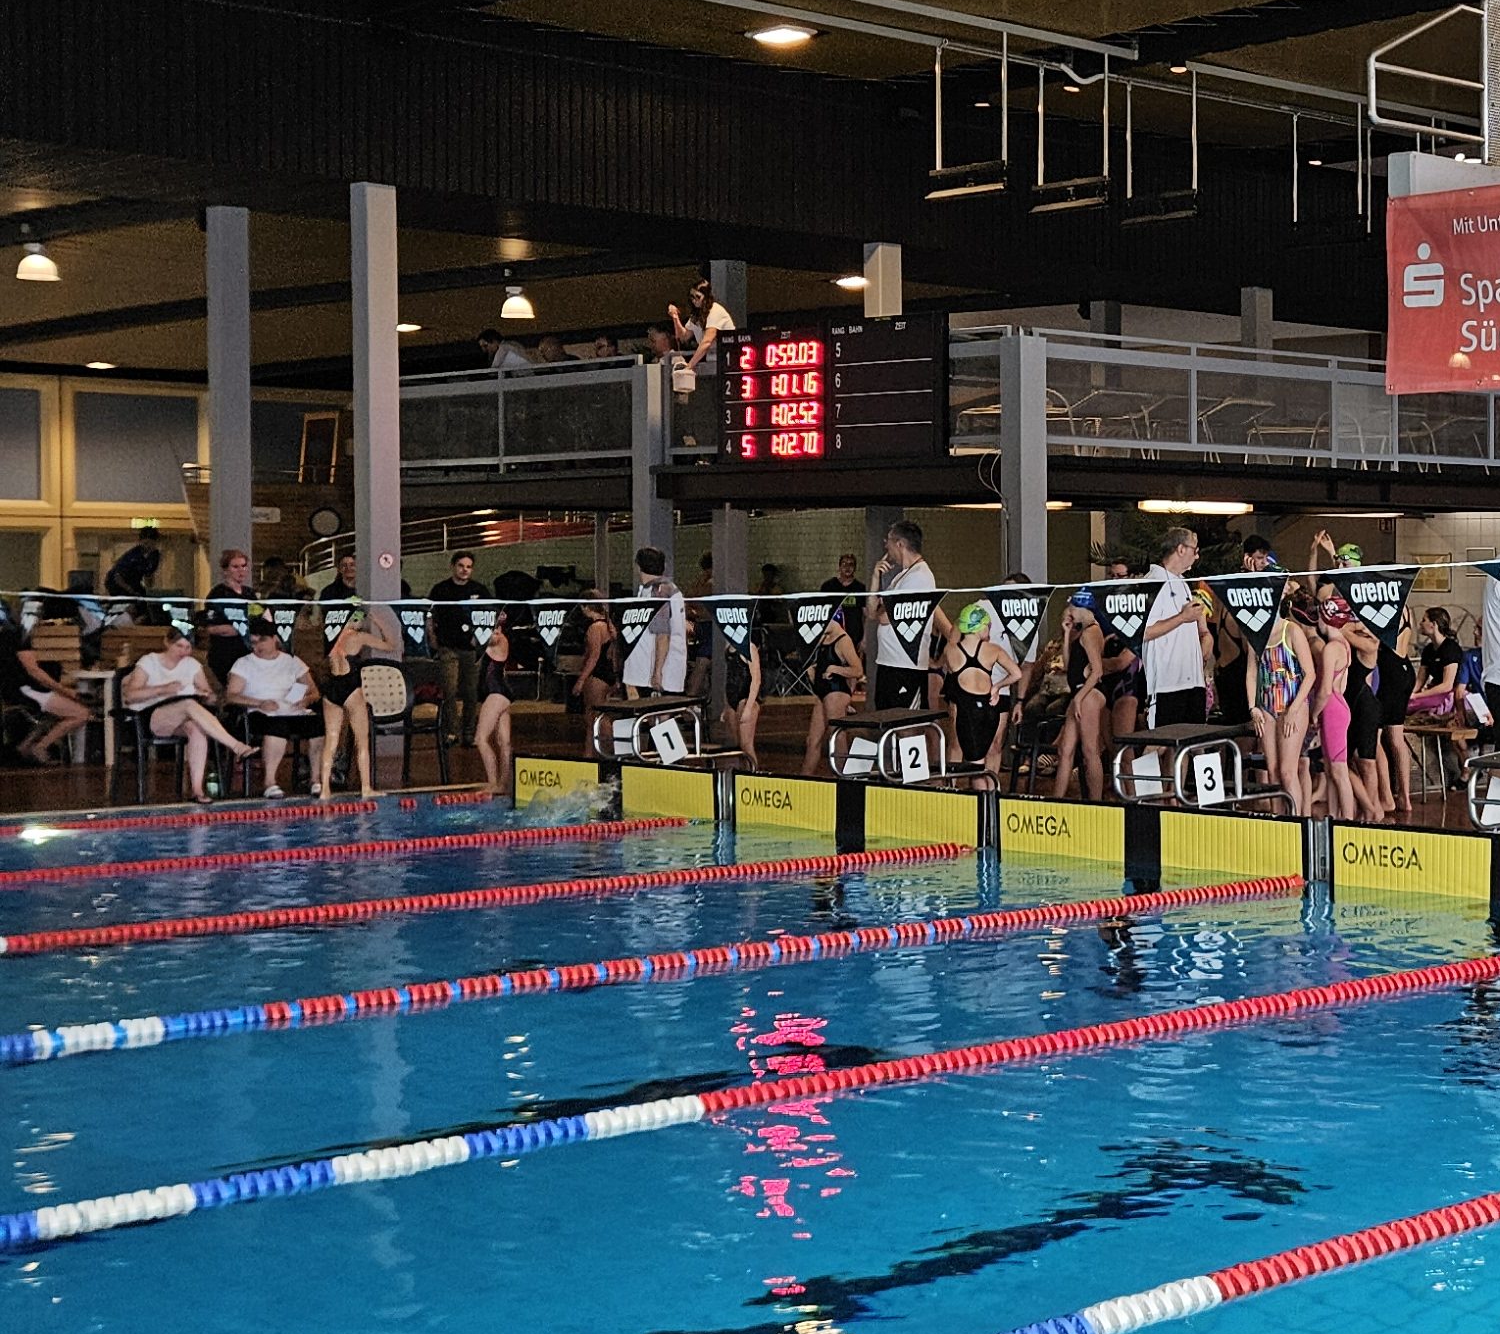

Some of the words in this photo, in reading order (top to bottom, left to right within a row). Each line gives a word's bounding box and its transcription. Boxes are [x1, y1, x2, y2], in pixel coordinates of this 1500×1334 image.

[1453, 217, 1475, 235] Mit
[740, 346, 753, 369] 2
[835, 342, 841, 357] 5
[741, 376, 753, 398] 3
[835, 373, 841, 388] 6
[835, 404, 841, 418] 7
[741, 434, 753, 458] 5
[835, 434, 841, 449] 8
[1227, 587, 1273, 607] arena
[1351, 581, 1400, 603] arena
[894, 601, 929, 620] arena
[1001, 598, 1039, 617] arena
[1106, 593, 1146, 614] arena
[538, 610, 566, 626] arena
[622, 608, 652, 624] arena
[716, 607, 748, 624] arena
[797, 604, 832, 623] arena
[662, 731, 675, 751] 1
[908, 747, 921, 769] 2
[519, 769, 562, 788] OMEGA
[1203, 766, 1216, 791] 3
[741, 787, 793, 811] OMEGA
[1006, 813, 1072, 838] OMEGA
[1342, 842, 1423, 871] OMEGA
